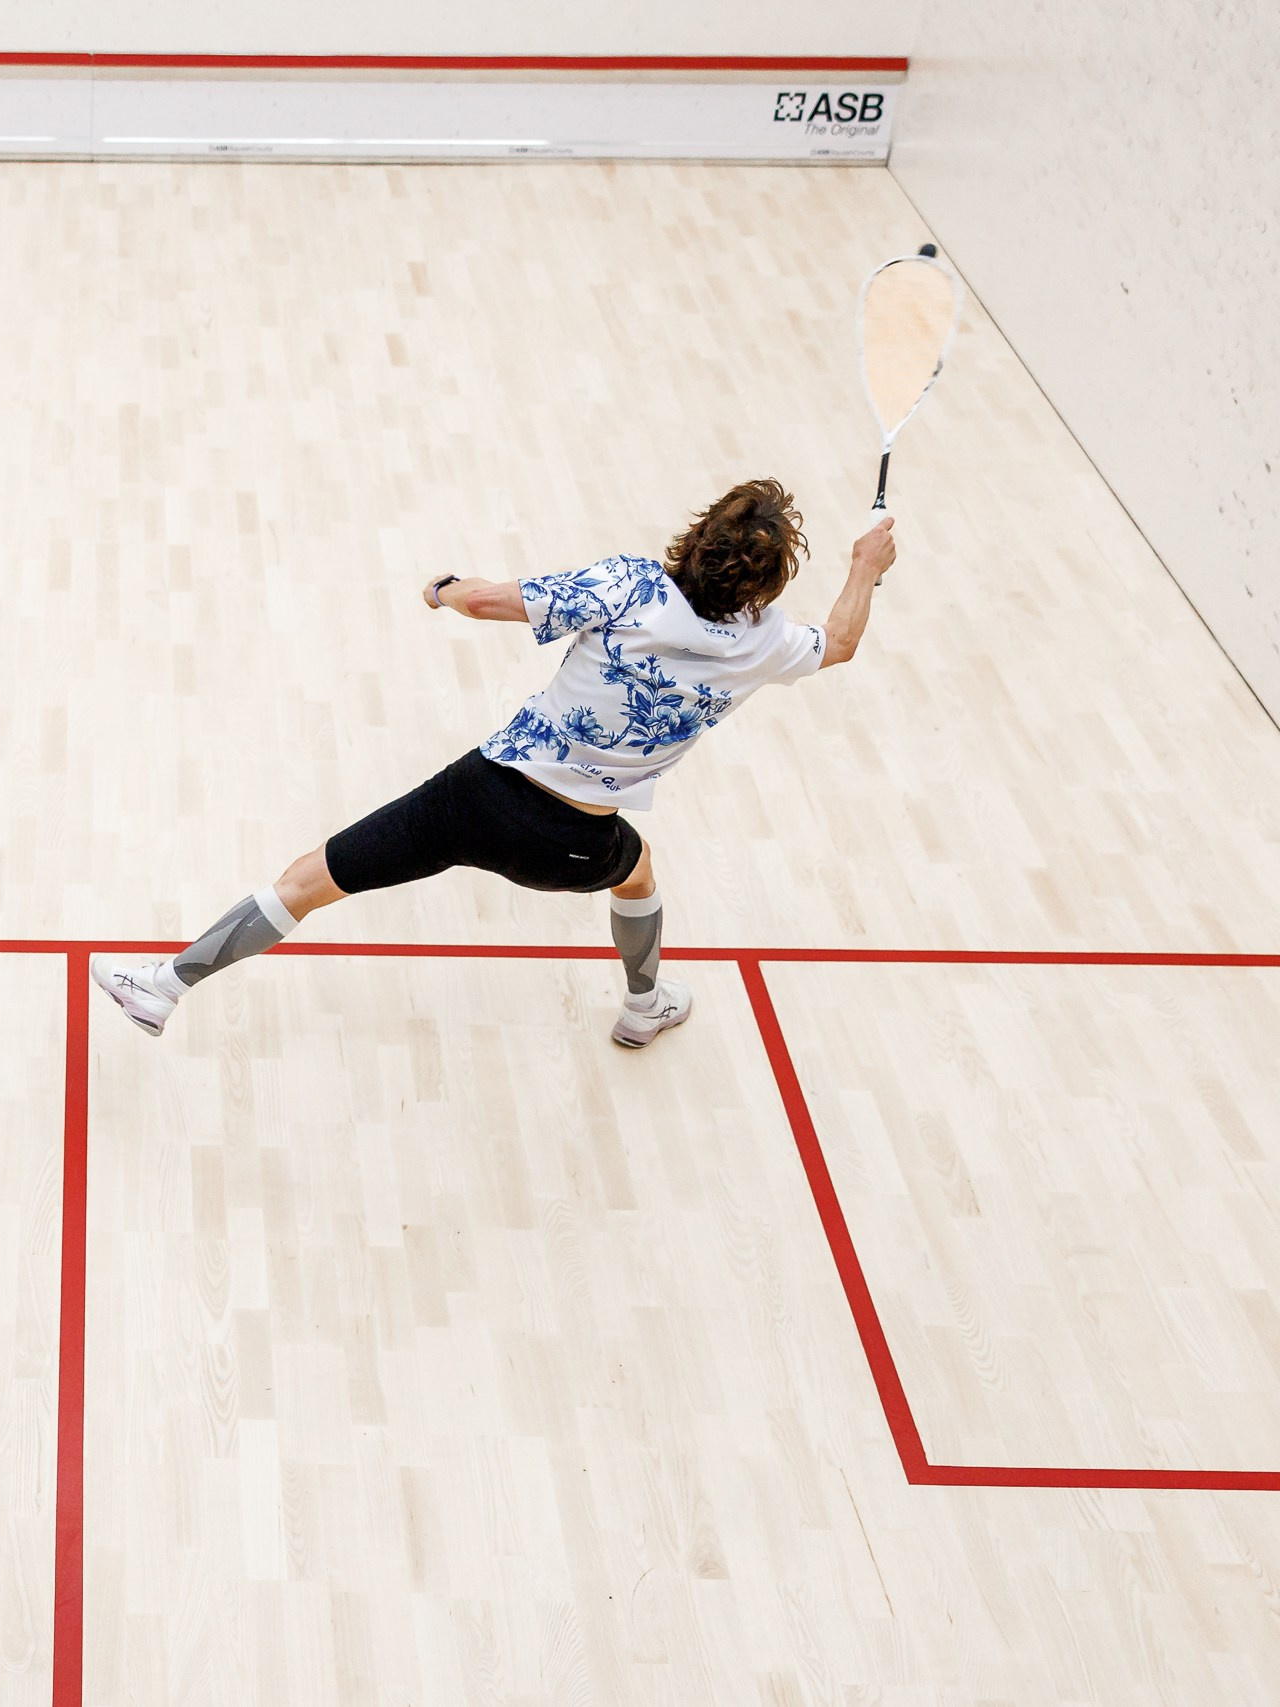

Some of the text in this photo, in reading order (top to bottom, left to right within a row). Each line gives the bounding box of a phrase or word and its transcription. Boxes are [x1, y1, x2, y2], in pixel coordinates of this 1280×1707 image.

[807, 92, 884, 122] ASB
[804, 124, 880, 138] The Original
